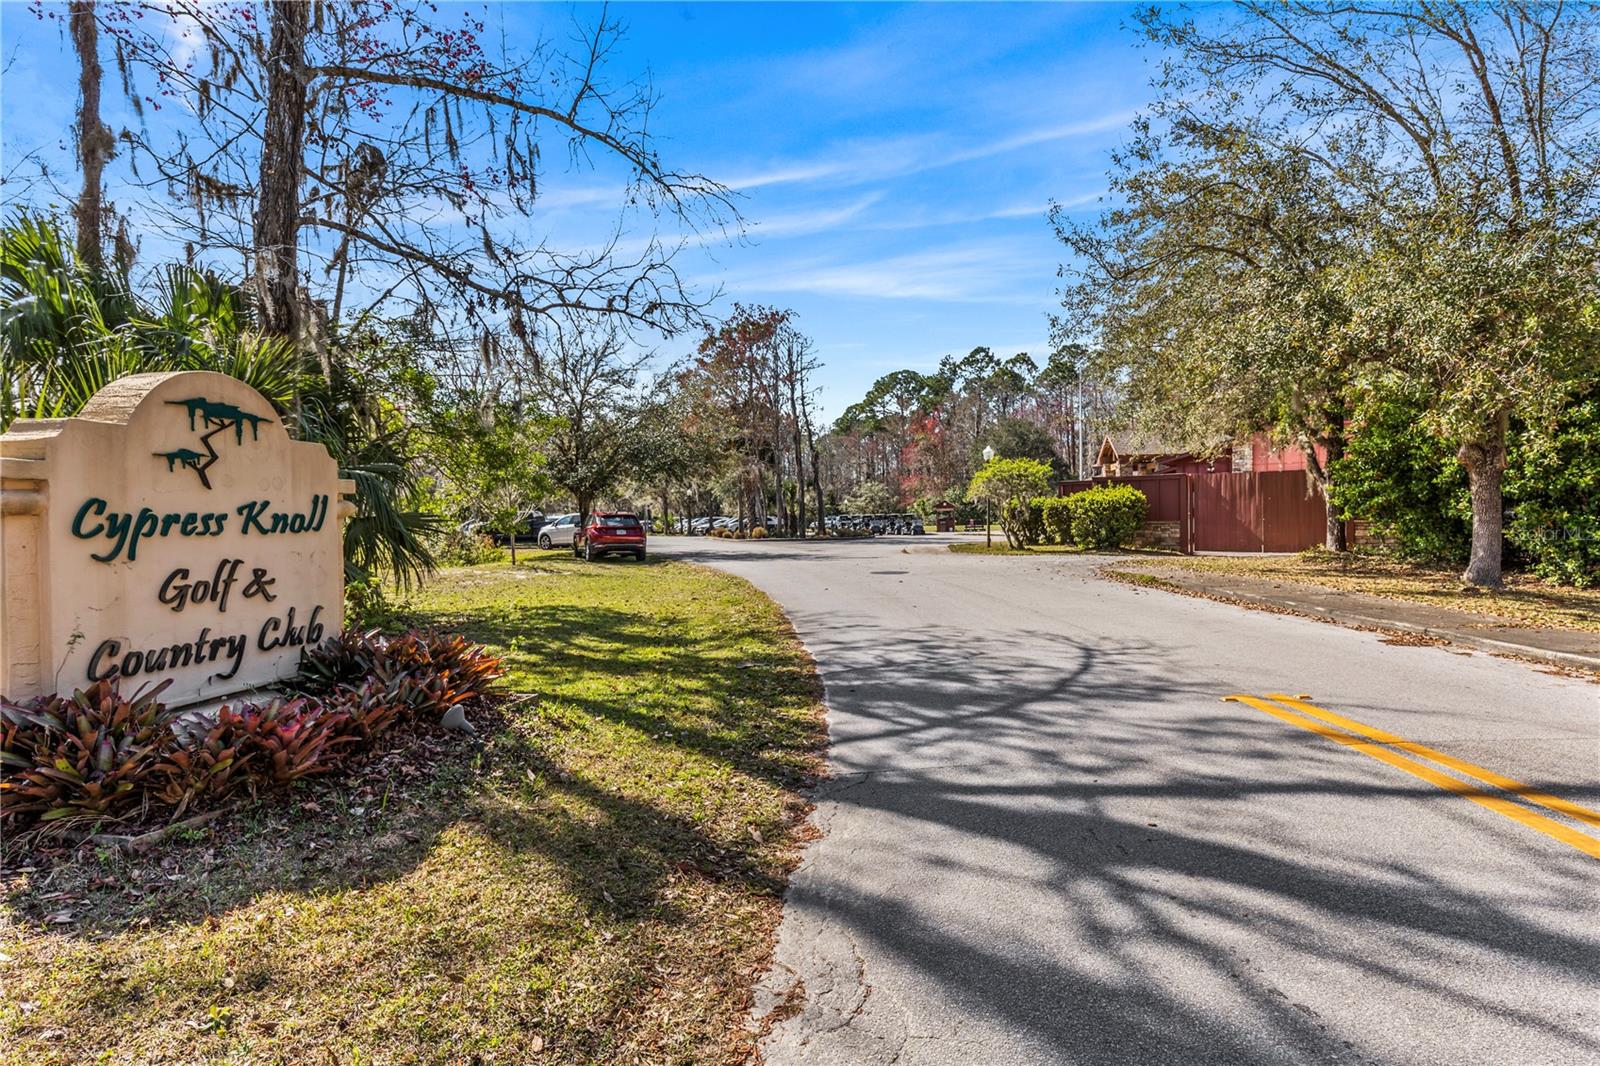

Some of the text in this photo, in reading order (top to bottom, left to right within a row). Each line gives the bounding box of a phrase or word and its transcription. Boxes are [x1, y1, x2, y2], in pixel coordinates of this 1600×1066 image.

[71, 494, 329, 562] Cypress Knoll
[158, 558, 277, 612] Golf &
[87, 605, 325, 685] Country Club
